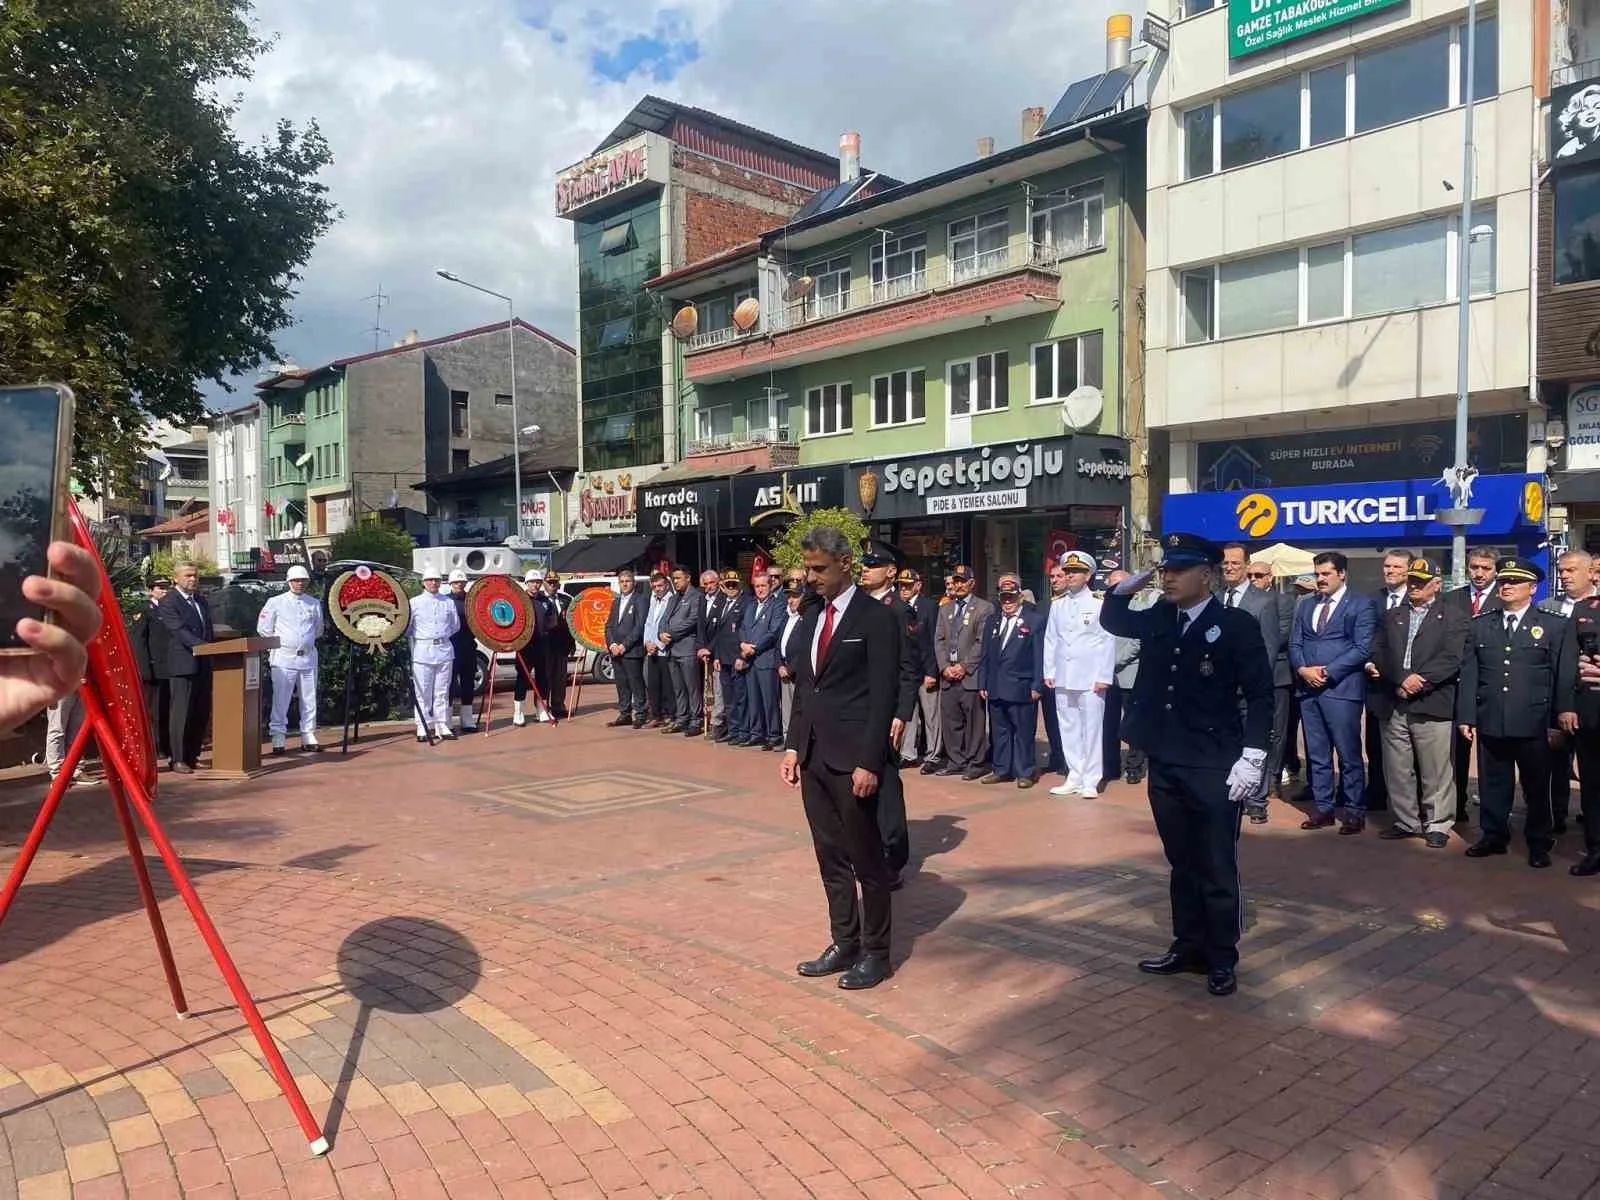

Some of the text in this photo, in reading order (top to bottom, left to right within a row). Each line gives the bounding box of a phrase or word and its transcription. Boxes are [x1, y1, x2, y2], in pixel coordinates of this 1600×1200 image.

[1237, 14, 1272, 37] GAMZE
[1244, 34, 1264, 47] Özel
[1266, 24, 1293, 40] Sağlık
[1295, 12, 1327, 30] Meslek
[1270, 447, 1300, 460] SÜPER
[1303, 447, 1328, 458] HIZLI
[1330, 446, 1344, 456] EV
[1311, 458, 1355, 470] BURADA
[884, 443, 1063, 495] Sepetçioğlu
[933, 493, 1019, 511] PİDE & YEMEK SALONU
[1281, 495, 1436, 526] TURKCELL
[660, 507, 699, 531] Optik
